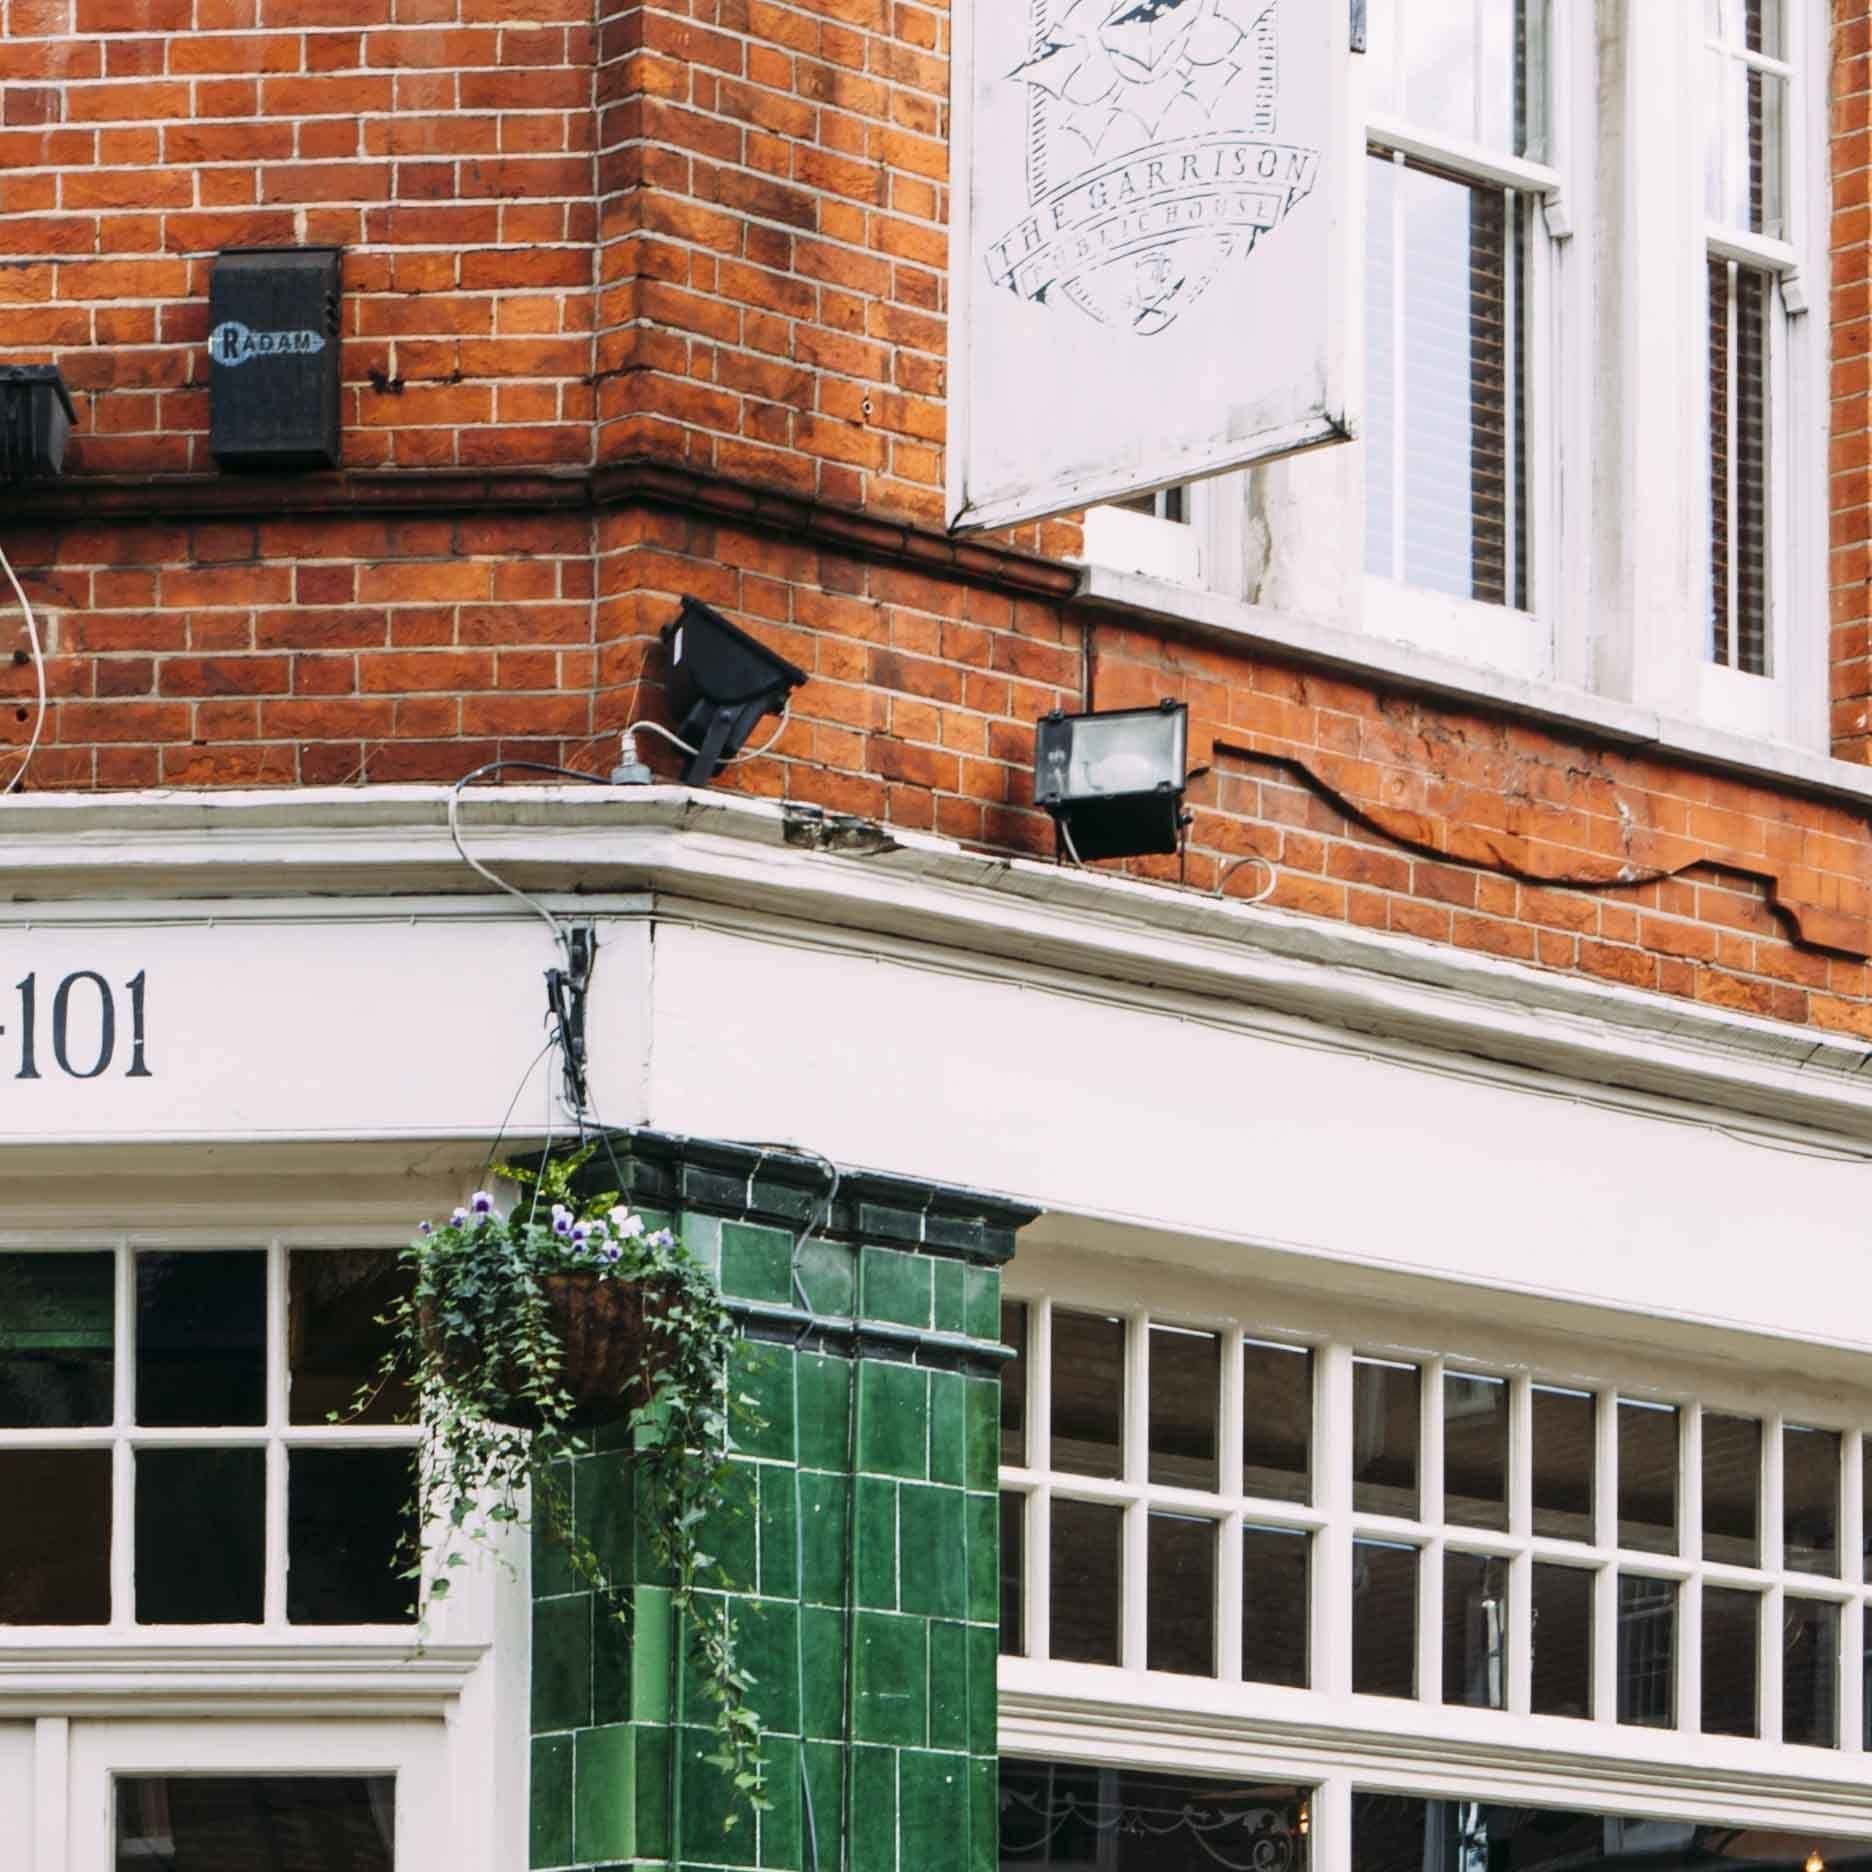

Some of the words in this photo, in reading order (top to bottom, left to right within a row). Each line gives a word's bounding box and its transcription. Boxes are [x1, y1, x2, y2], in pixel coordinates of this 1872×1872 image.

[994, 202, 1073, 268] THE
[1088, 147, 1309, 209] GARRISON
[1165, 199, 1270, 226] HOUSE
[222, 326, 312, 360] RADAM
